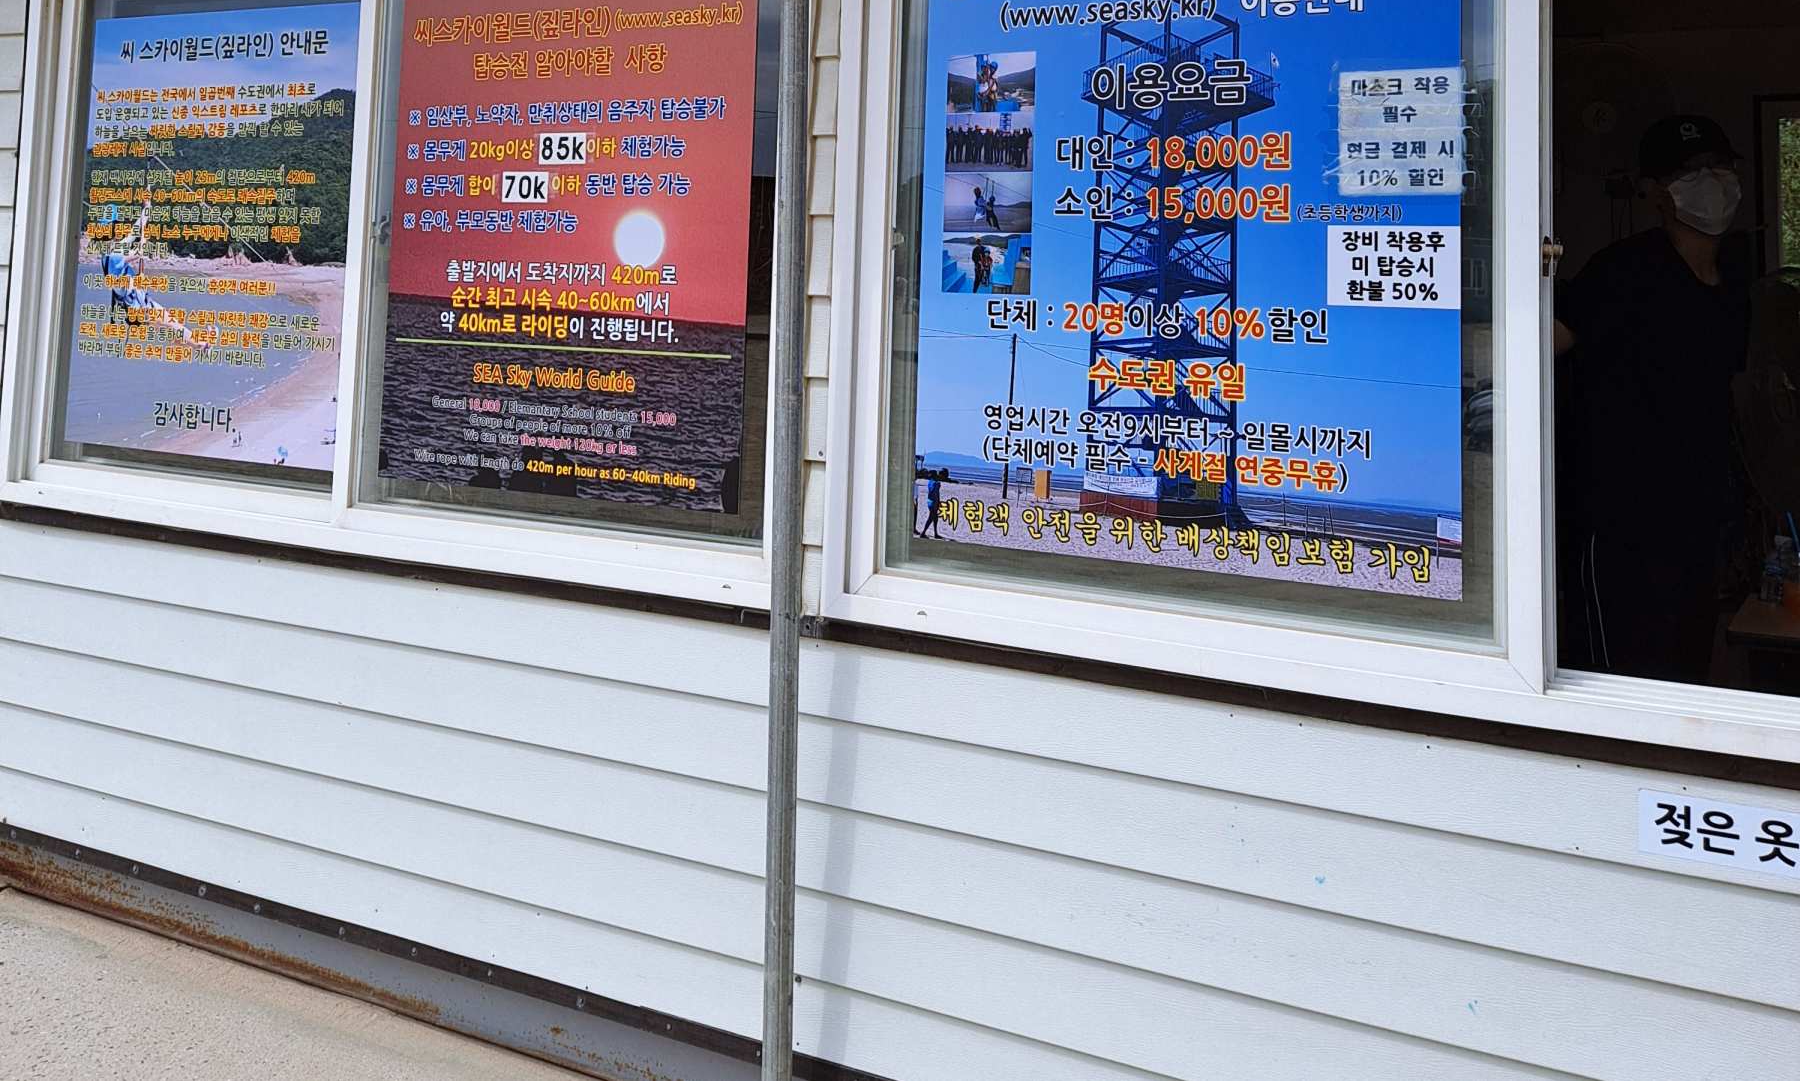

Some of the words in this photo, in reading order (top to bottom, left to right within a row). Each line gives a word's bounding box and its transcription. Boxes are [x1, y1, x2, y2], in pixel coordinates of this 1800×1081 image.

[121, 40, 135, 64] 씨
[280, 29, 329, 57] 안내문
[473, 50, 529, 80] 탑승전
[535, 46, 614, 79] 알아야할
[624, 43, 668, 74] 사항
[237, 83, 285, 99] 수도권에서
[1091, 59, 1252, 110] 이용요금
[426, 104, 472, 127] 임산부,
[476, 103, 523, 125] 노약자,
[528, 100, 602, 124] 만취상태의
[608, 98, 656, 121] 음주자
[661, 96, 726, 120] 탑승불가
[1382, 105, 1417, 123] 필수
[424, 139, 466, 161] 몸무게
[469, 139, 534, 161] 20kg이상
[587, 137, 617, 158] 이하
[1056, 134, 1114, 171] 대인
[1146, 132, 1292, 171] 18,000원
[1347, 141, 1381, 159] 현금
[1391, 140, 1426, 159] 결제
[1438, 140, 1454, 158] 시
[422, 175, 464, 197] 몸무게
[468, 175, 496, 196] 합이
[552, 175, 581, 196] 이하
[585, 174, 617, 196] 동반
[622, 173, 653, 196] 탑승
[657, 173, 691, 196] 가능
[1357, 169, 1398, 187] 10%
[1408, 168, 1444, 187] 할인
[1053, 185, 1114, 222] 소인
[1145, 183, 1291, 224] 15,000원
[1297, 204, 1402, 223] (초등학생까지)
[456, 210, 514, 232] 부모동반
[518, 210, 578, 233] 체험가능
[1342, 231, 1379, 252] 장비
[1387, 231, 1446, 253] 착용후
[446, 259, 522, 284] 출발지에서
[526, 261, 606, 286] 도착지까지
[611, 264, 678, 286] 420m로
[1352, 256, 1369, 277] 미
[1377, 256, 1434, 278] 탑승시
[451, 286, 481, 308] 순간
[486, 286, 517, 310] 최고
[521, 288, 553, 311] 시속
[556, 290, 670, 316] 40~60km에서
[1346, 280, 1385, 302] 환불
[1392, 282, 1438, 302] 50%
[290, 314, 320, 331] 새로운
[440, 310, 456, 333] 약
[458, 312, 517, 333] 40km로
[521, 314, 585, 340] 라이딩이
[590, 316, 680, 344] 진행됩니다.
[987, 299, 1038, 332] 단체
[1063, 302, 1184, 340] 20명이상
[273, 333, 302, 350] 만들어
[305, 335, 335, 352] 가시기
[473, 363, 503, 385] SEA
[506, 364, 532, 389] Sky
[535, 366, 583, 390] World
[586, 368, 636, 393] Guide
[1089, 357, 1176, 396] 수도권
[1185, 362, 1246, 401] 유일
[153, 402, 236, 434] 감사합니다.
[432, 395, 466, 410] General
[562, 405, 595, 421] School
[595, 408, 638, 424] students
[640, 410, 677, 426] 15,000
[469, 414, 502, 429] Groups
[504, 416, 515, 429] of
[516, 418, 548, 434] people
[562, 423, 588, 436] more
[591, 423, 613, 438] 10%
[616, 425, 632, 439] off
[984, 404, 1070, 436] 영업시간
[1077, 413, 1209, 447] 오전9시부터
[1244, 421, 1371, 461] 일몰시까지
[463, 428, 479, 442] We
[480, 431, 497, 443] can
[499, 431, 519, 446] take
[519, 432, 536, 447] the
[538, 435, 571, 452] weight
[606, 443, 617, 455] or
[618, 441, 637, 456] less
[414, 448, 435, 463] Wire
[436, 453, 457, 467] rope
[459, 453, 479, 468] with
[480, 454, 510, 471] length
[526, 459, 554, 475] 420m
[556, 463, 573, 478] per
[574, 463, 596, 479] hour
[599, 469, 610, 480] as
[663, 472, 697, 490] Riding
[982, 435, 1078, 469] (단체예약
[1085, 443, 1131, 472] 필수
[1153, 449, 1227, 483] 사계절
[1235, 455, 1350, 494] 연중무휴)
[938, 497, 1010, 536] 체험객
[1022, 506, 1101, 546] 안전을
[1110, 516, 1167, 553] 위한
[1368, 542, 1431, 583] 가입
[1655, 802, 1740, 856] 젖은
